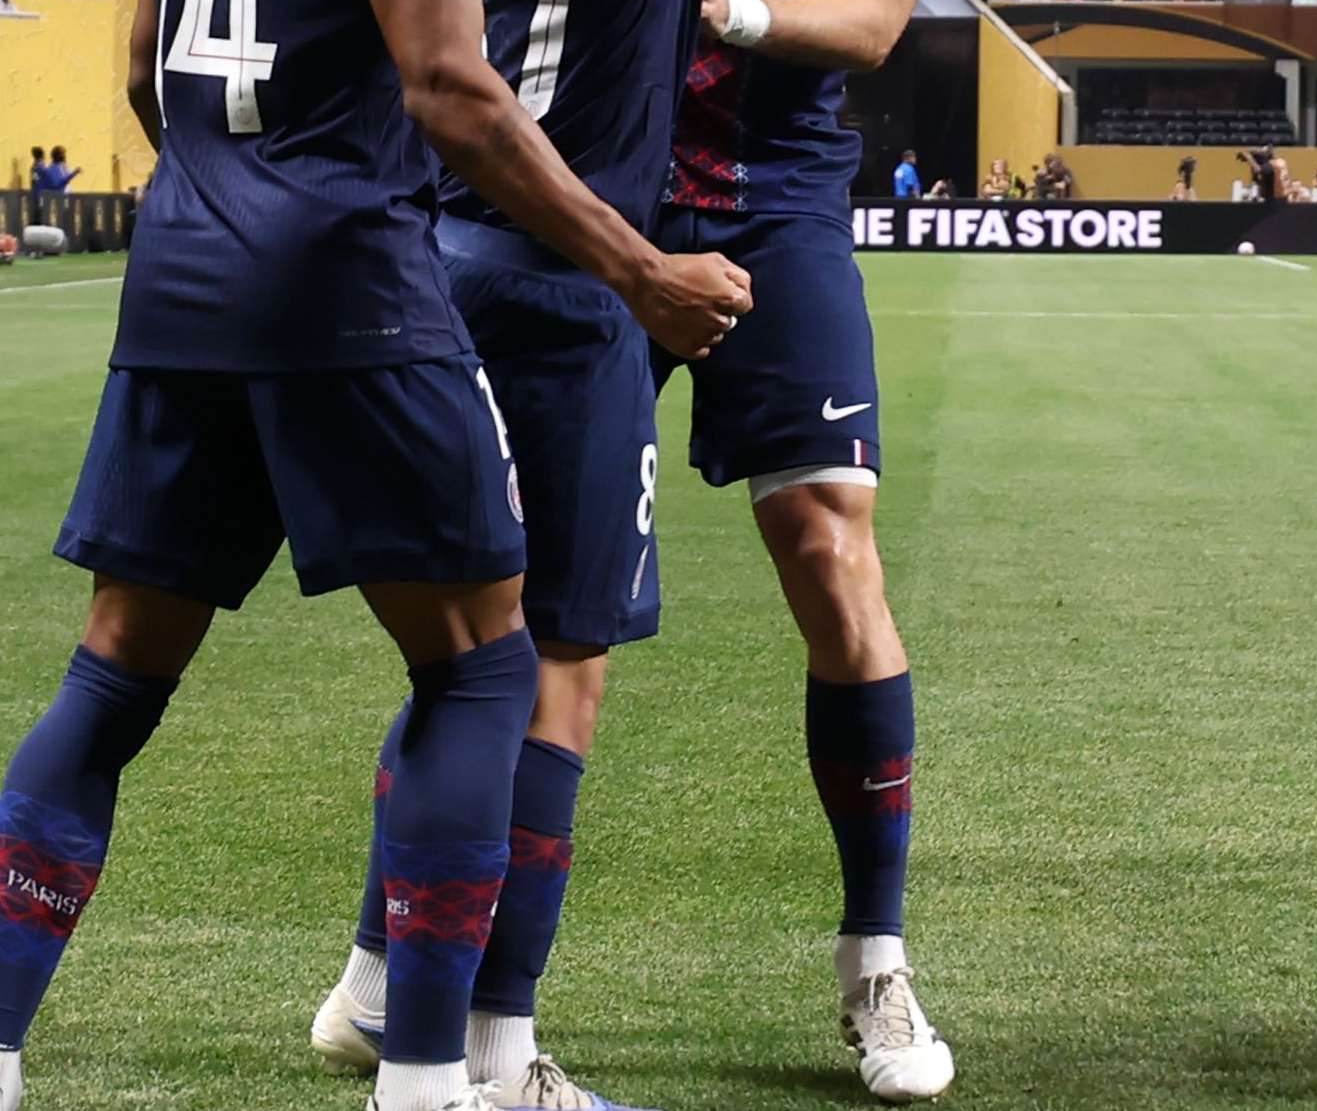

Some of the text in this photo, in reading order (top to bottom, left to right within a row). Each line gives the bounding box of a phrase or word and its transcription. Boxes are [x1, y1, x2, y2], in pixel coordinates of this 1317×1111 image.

[907, 208, 1013, 247] FIFA
[1016, 208, 1163, 248] STORE
[8, 868, 79, 916] PARIS
[386, 897, 410, 916] RIS
